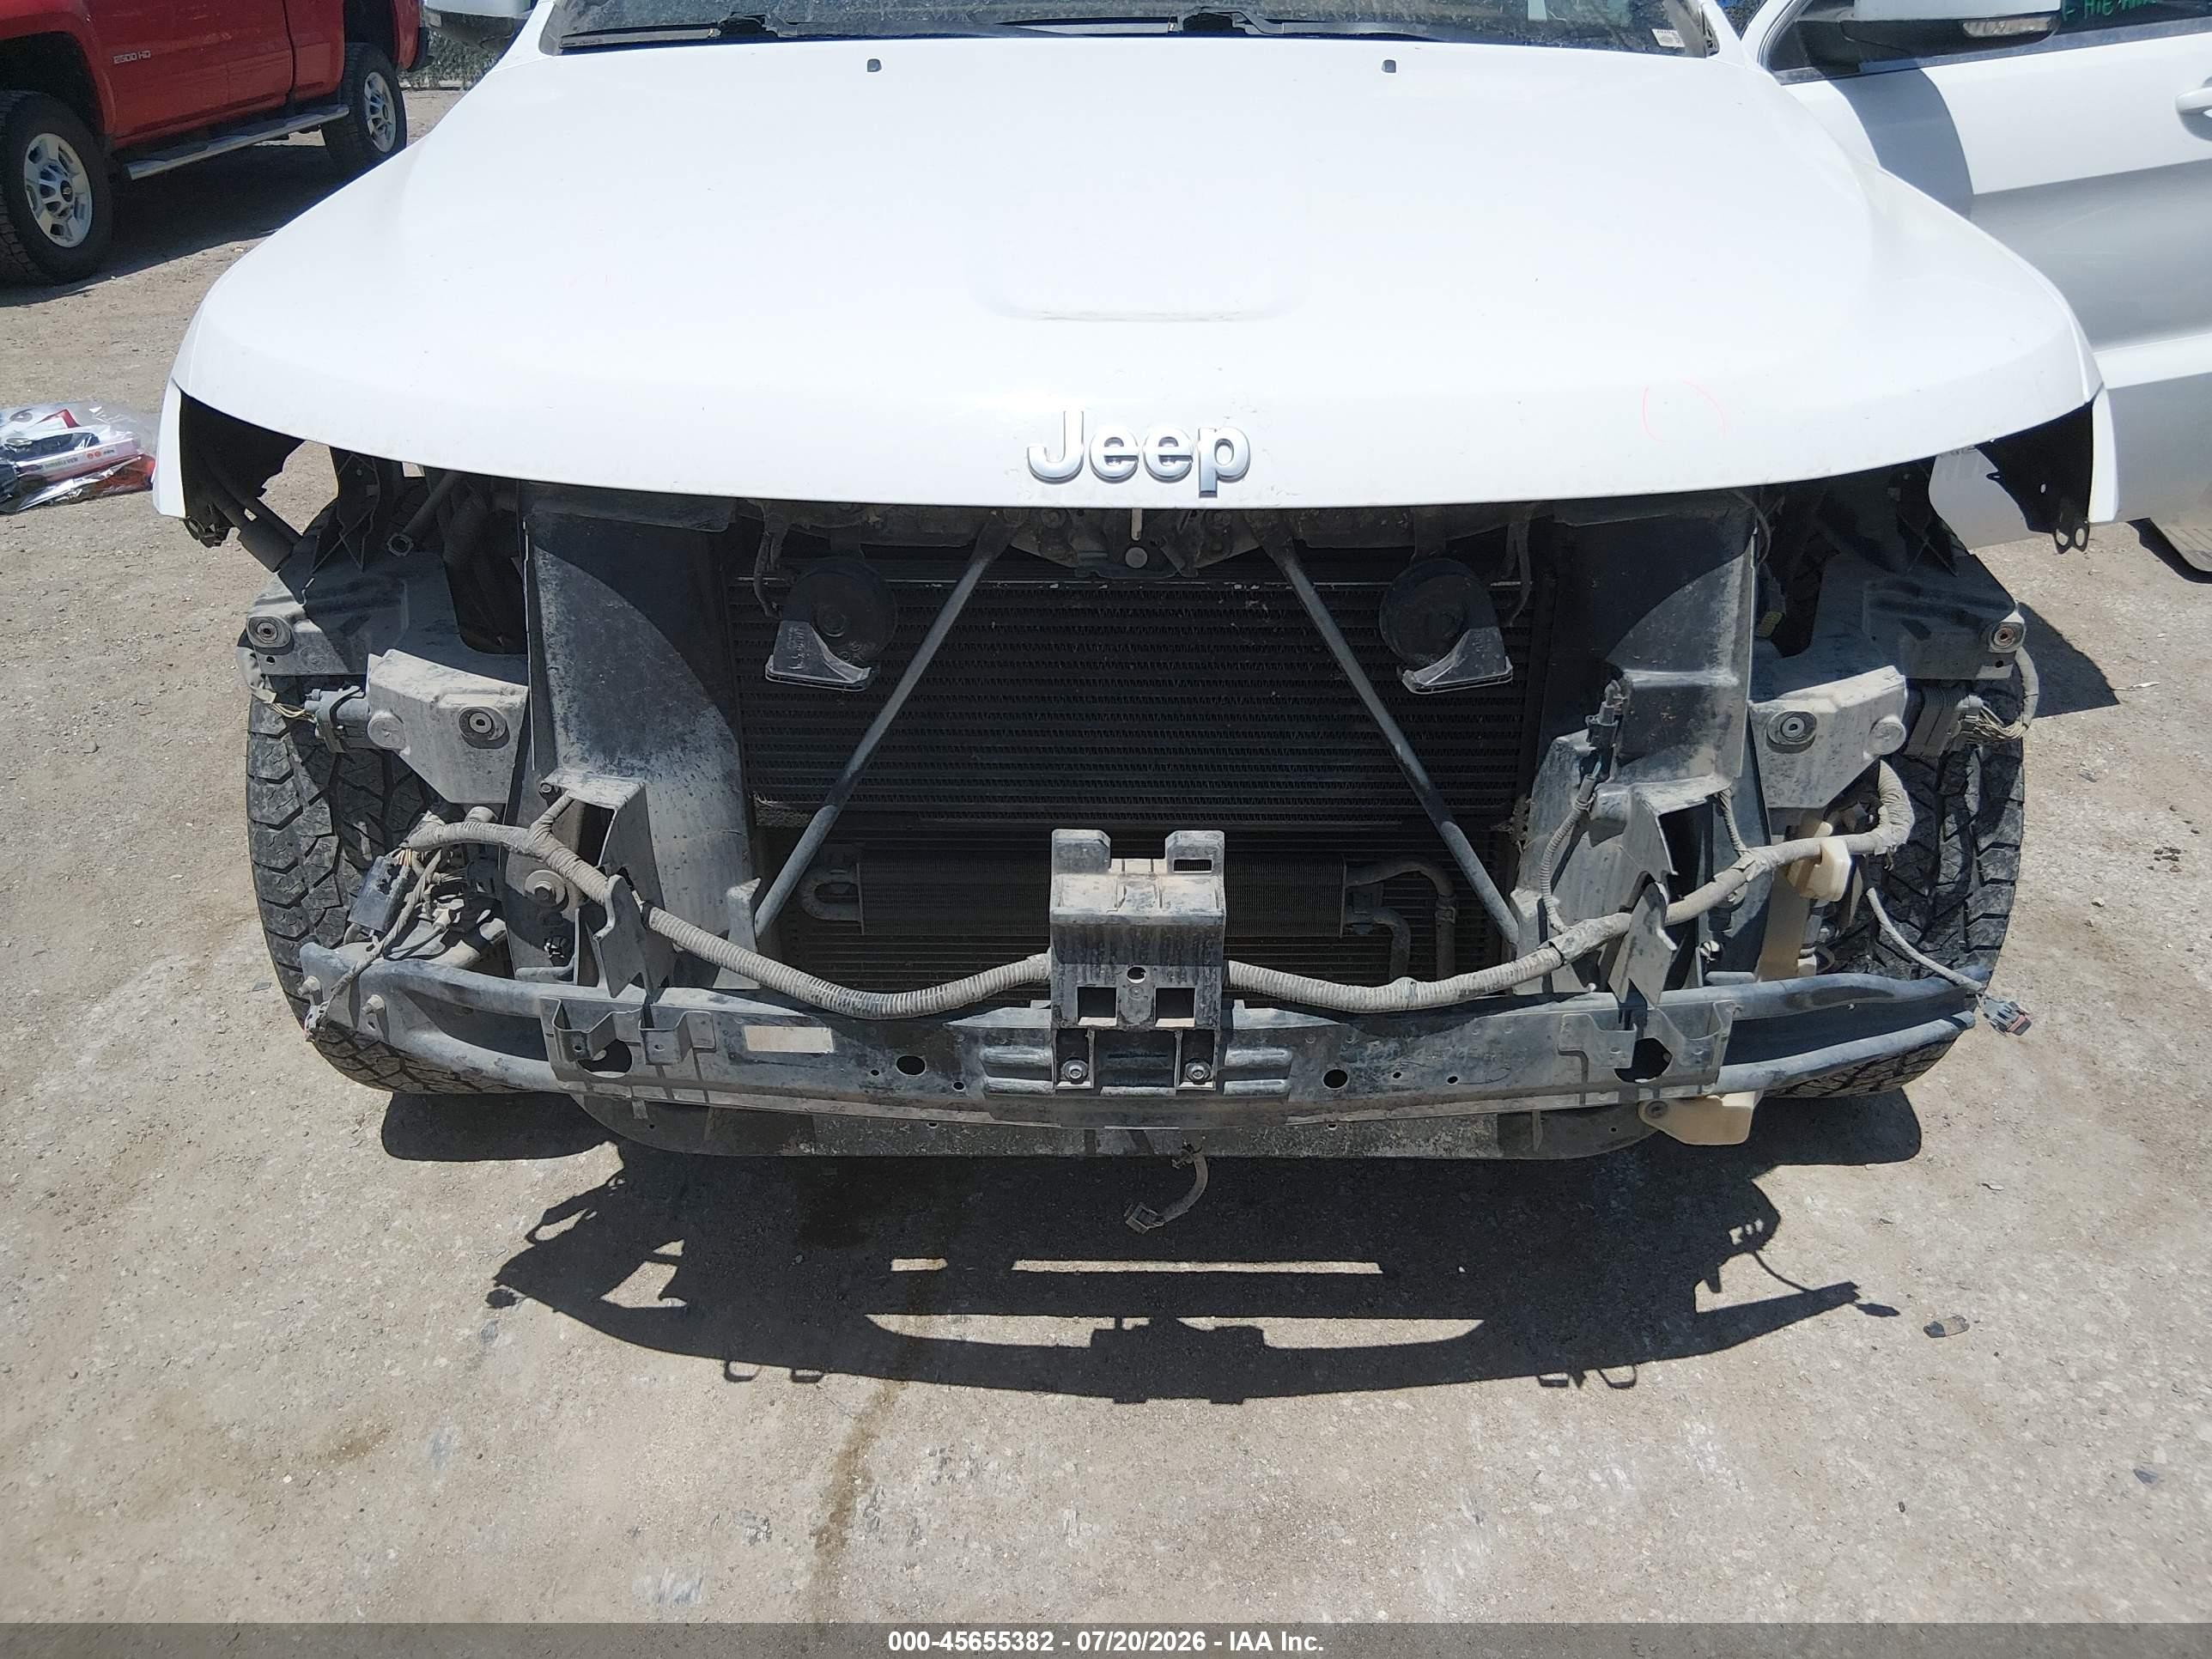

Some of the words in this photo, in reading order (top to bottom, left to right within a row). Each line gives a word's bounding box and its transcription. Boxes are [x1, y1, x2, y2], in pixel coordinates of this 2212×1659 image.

[113, 52, 137, 64] 2500
[137, 50, 151, 59] HD
[1027, 409, 1250, 498] Jeep
